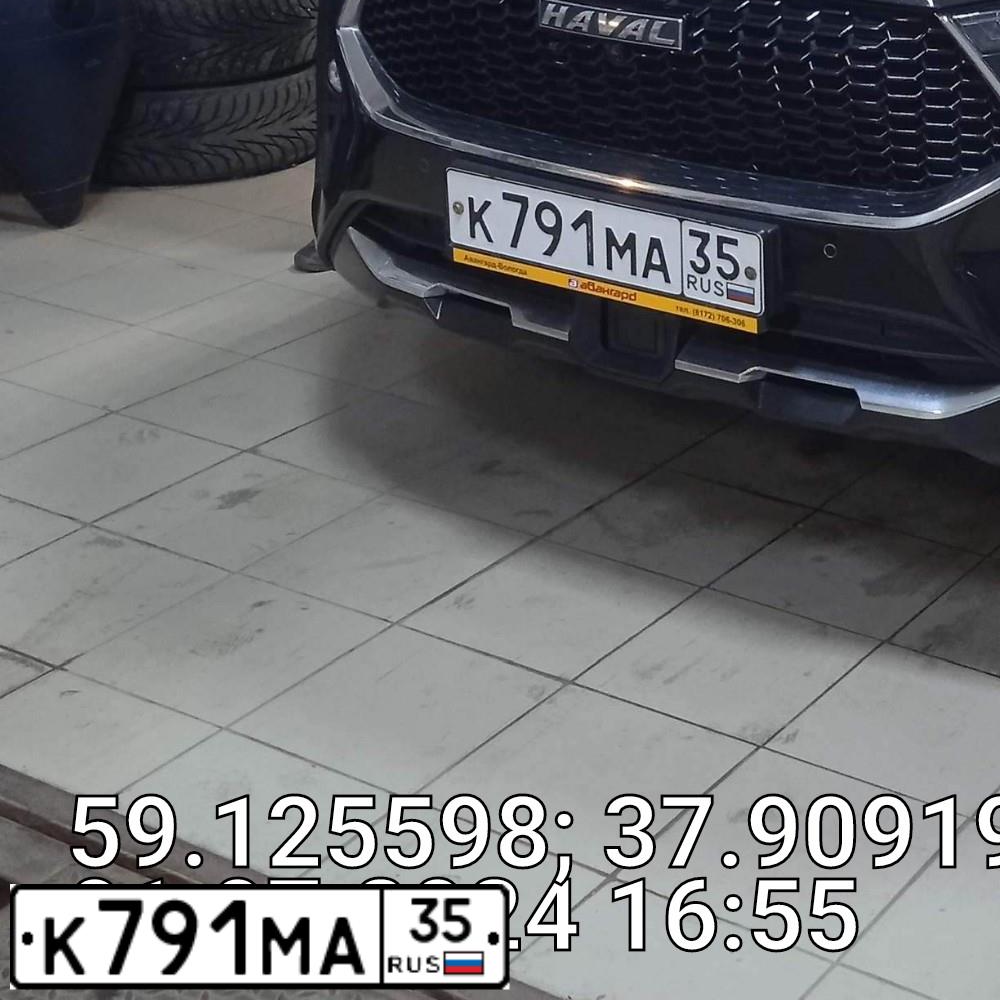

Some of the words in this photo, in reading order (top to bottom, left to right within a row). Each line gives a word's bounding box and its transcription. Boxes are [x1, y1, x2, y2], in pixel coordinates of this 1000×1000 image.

[541, 2, 676, 46] HAVAL
[467, 191, 672, 284] К791МА
[689, 229, 740, 281] 35
[687, 275, 724, 297] RUS
